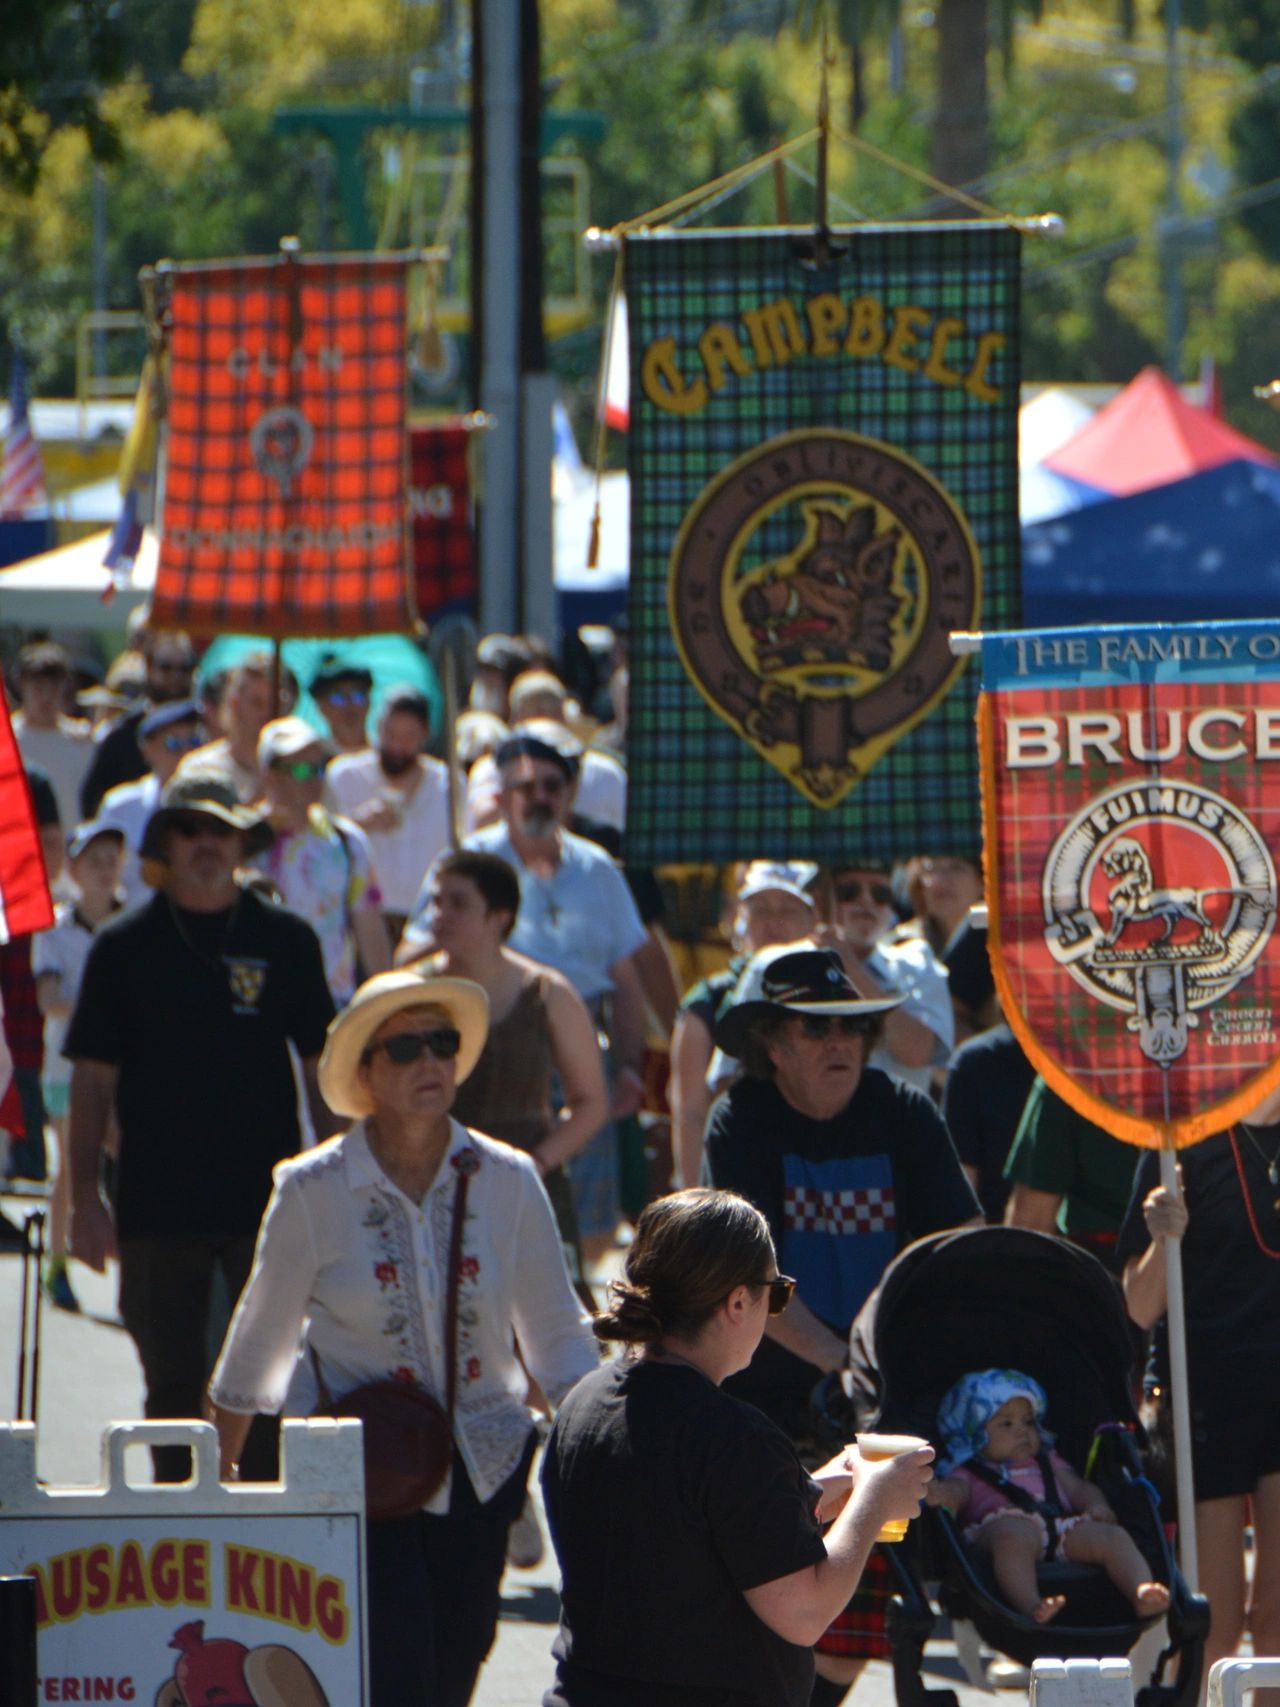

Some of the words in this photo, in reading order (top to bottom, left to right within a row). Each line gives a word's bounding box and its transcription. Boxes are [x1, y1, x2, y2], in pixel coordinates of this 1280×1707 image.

[642, 293, 1006, 413] CAMPBELL
[1089, 787, 1223, 834] FUIMUS
[225, 1544, 347, 1643] KING
